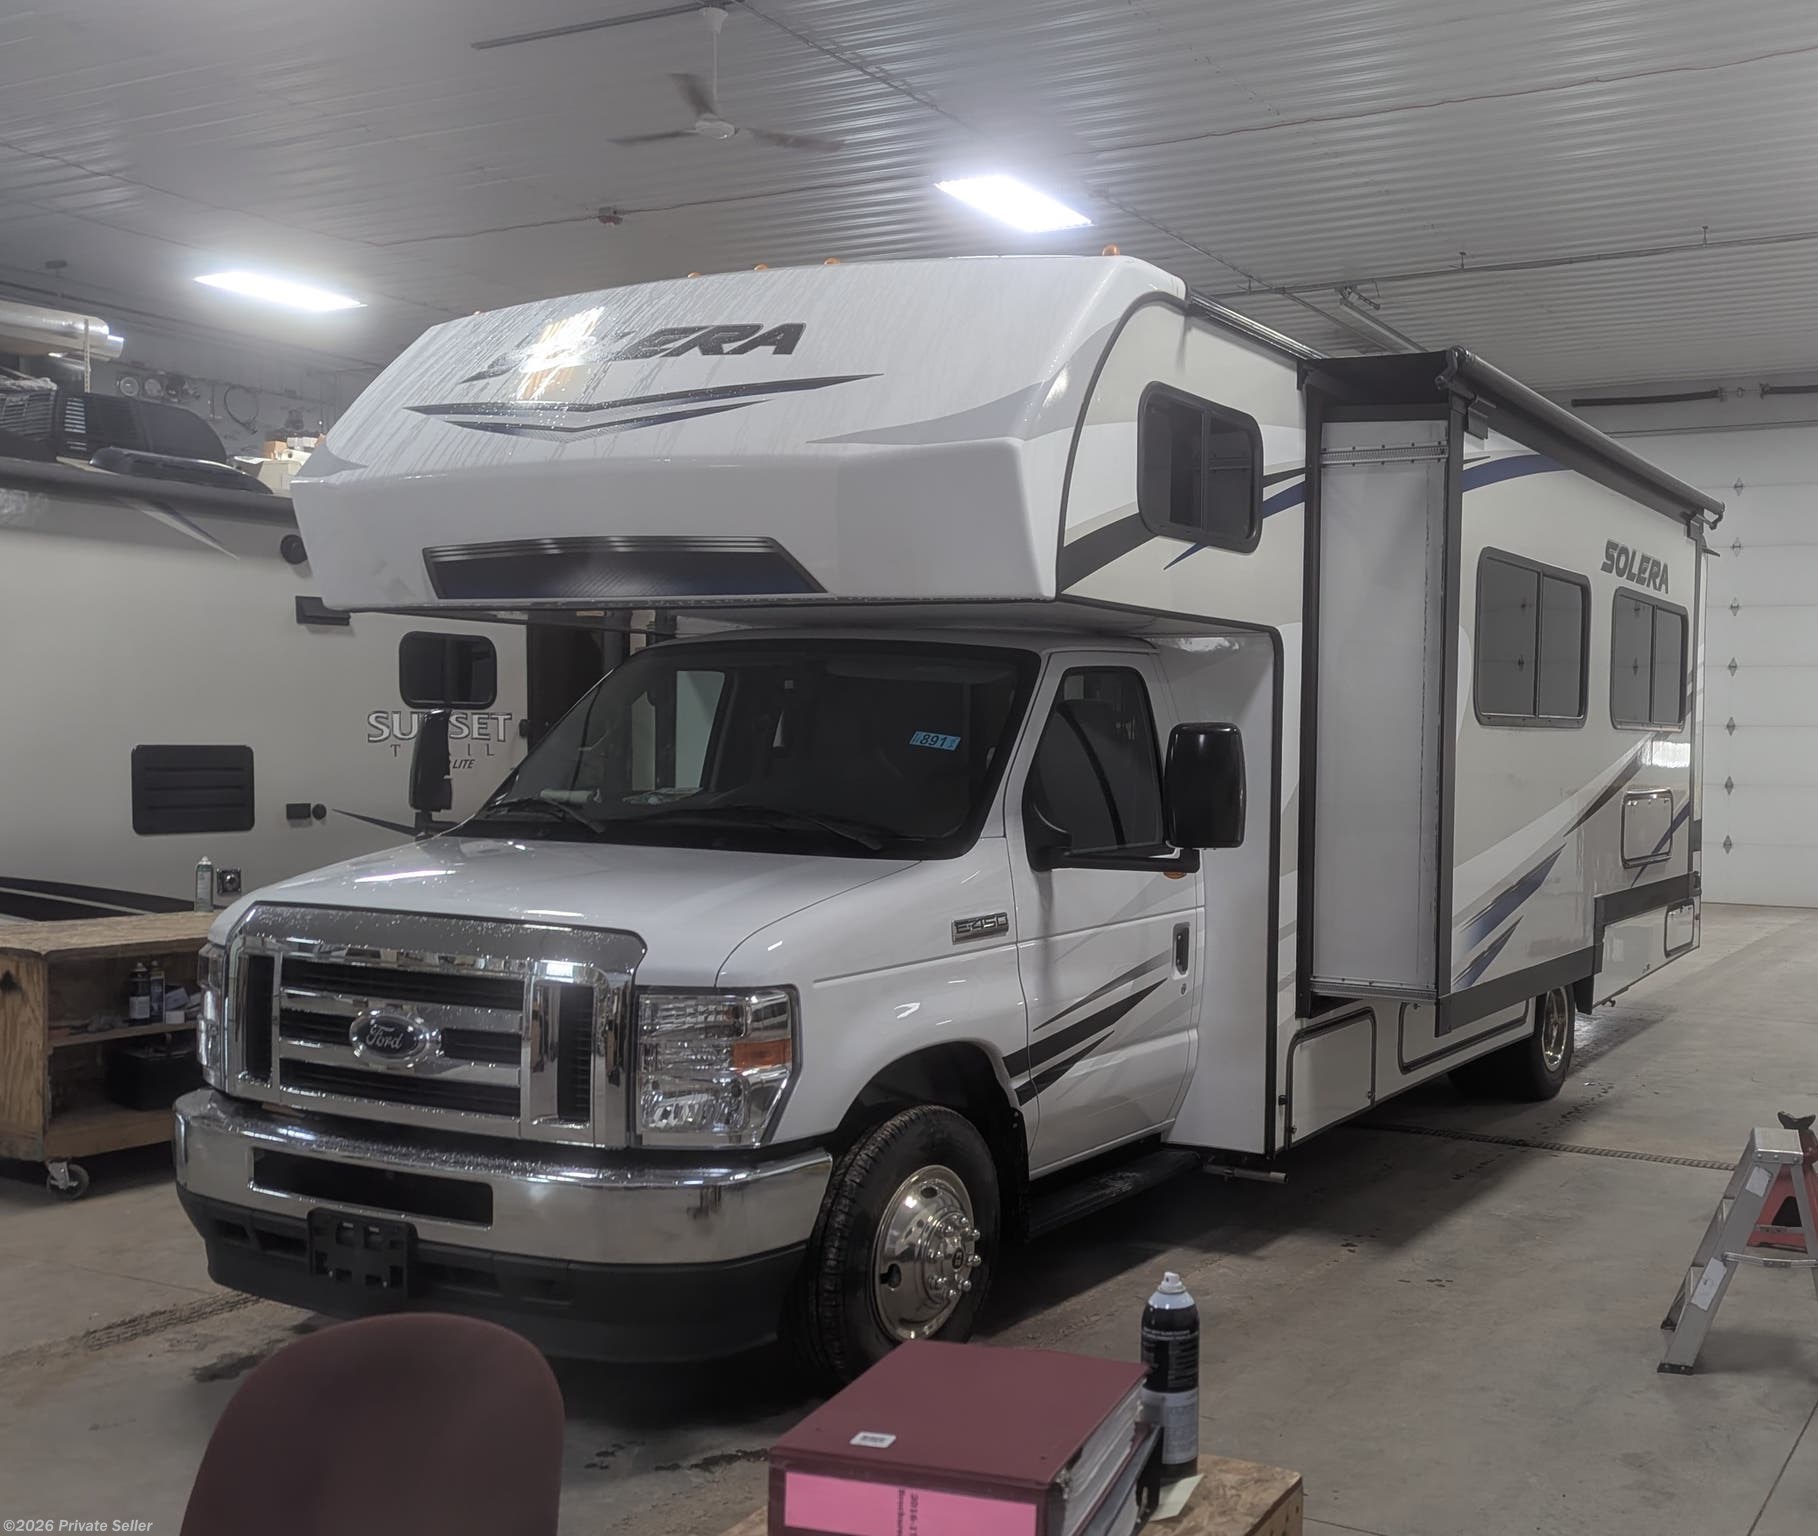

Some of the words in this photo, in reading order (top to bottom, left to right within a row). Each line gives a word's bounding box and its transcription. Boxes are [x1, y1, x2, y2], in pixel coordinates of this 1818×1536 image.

[1600, 540, 1669, 595] SOLERA
[367, 710, 513, 743] SUSET
[390, 743, 496, 757] TIL
[919, 733, 948, 748] 891
[452, 758, 476, 769] LITE
[366, 1023, 404, 1049] Ford
